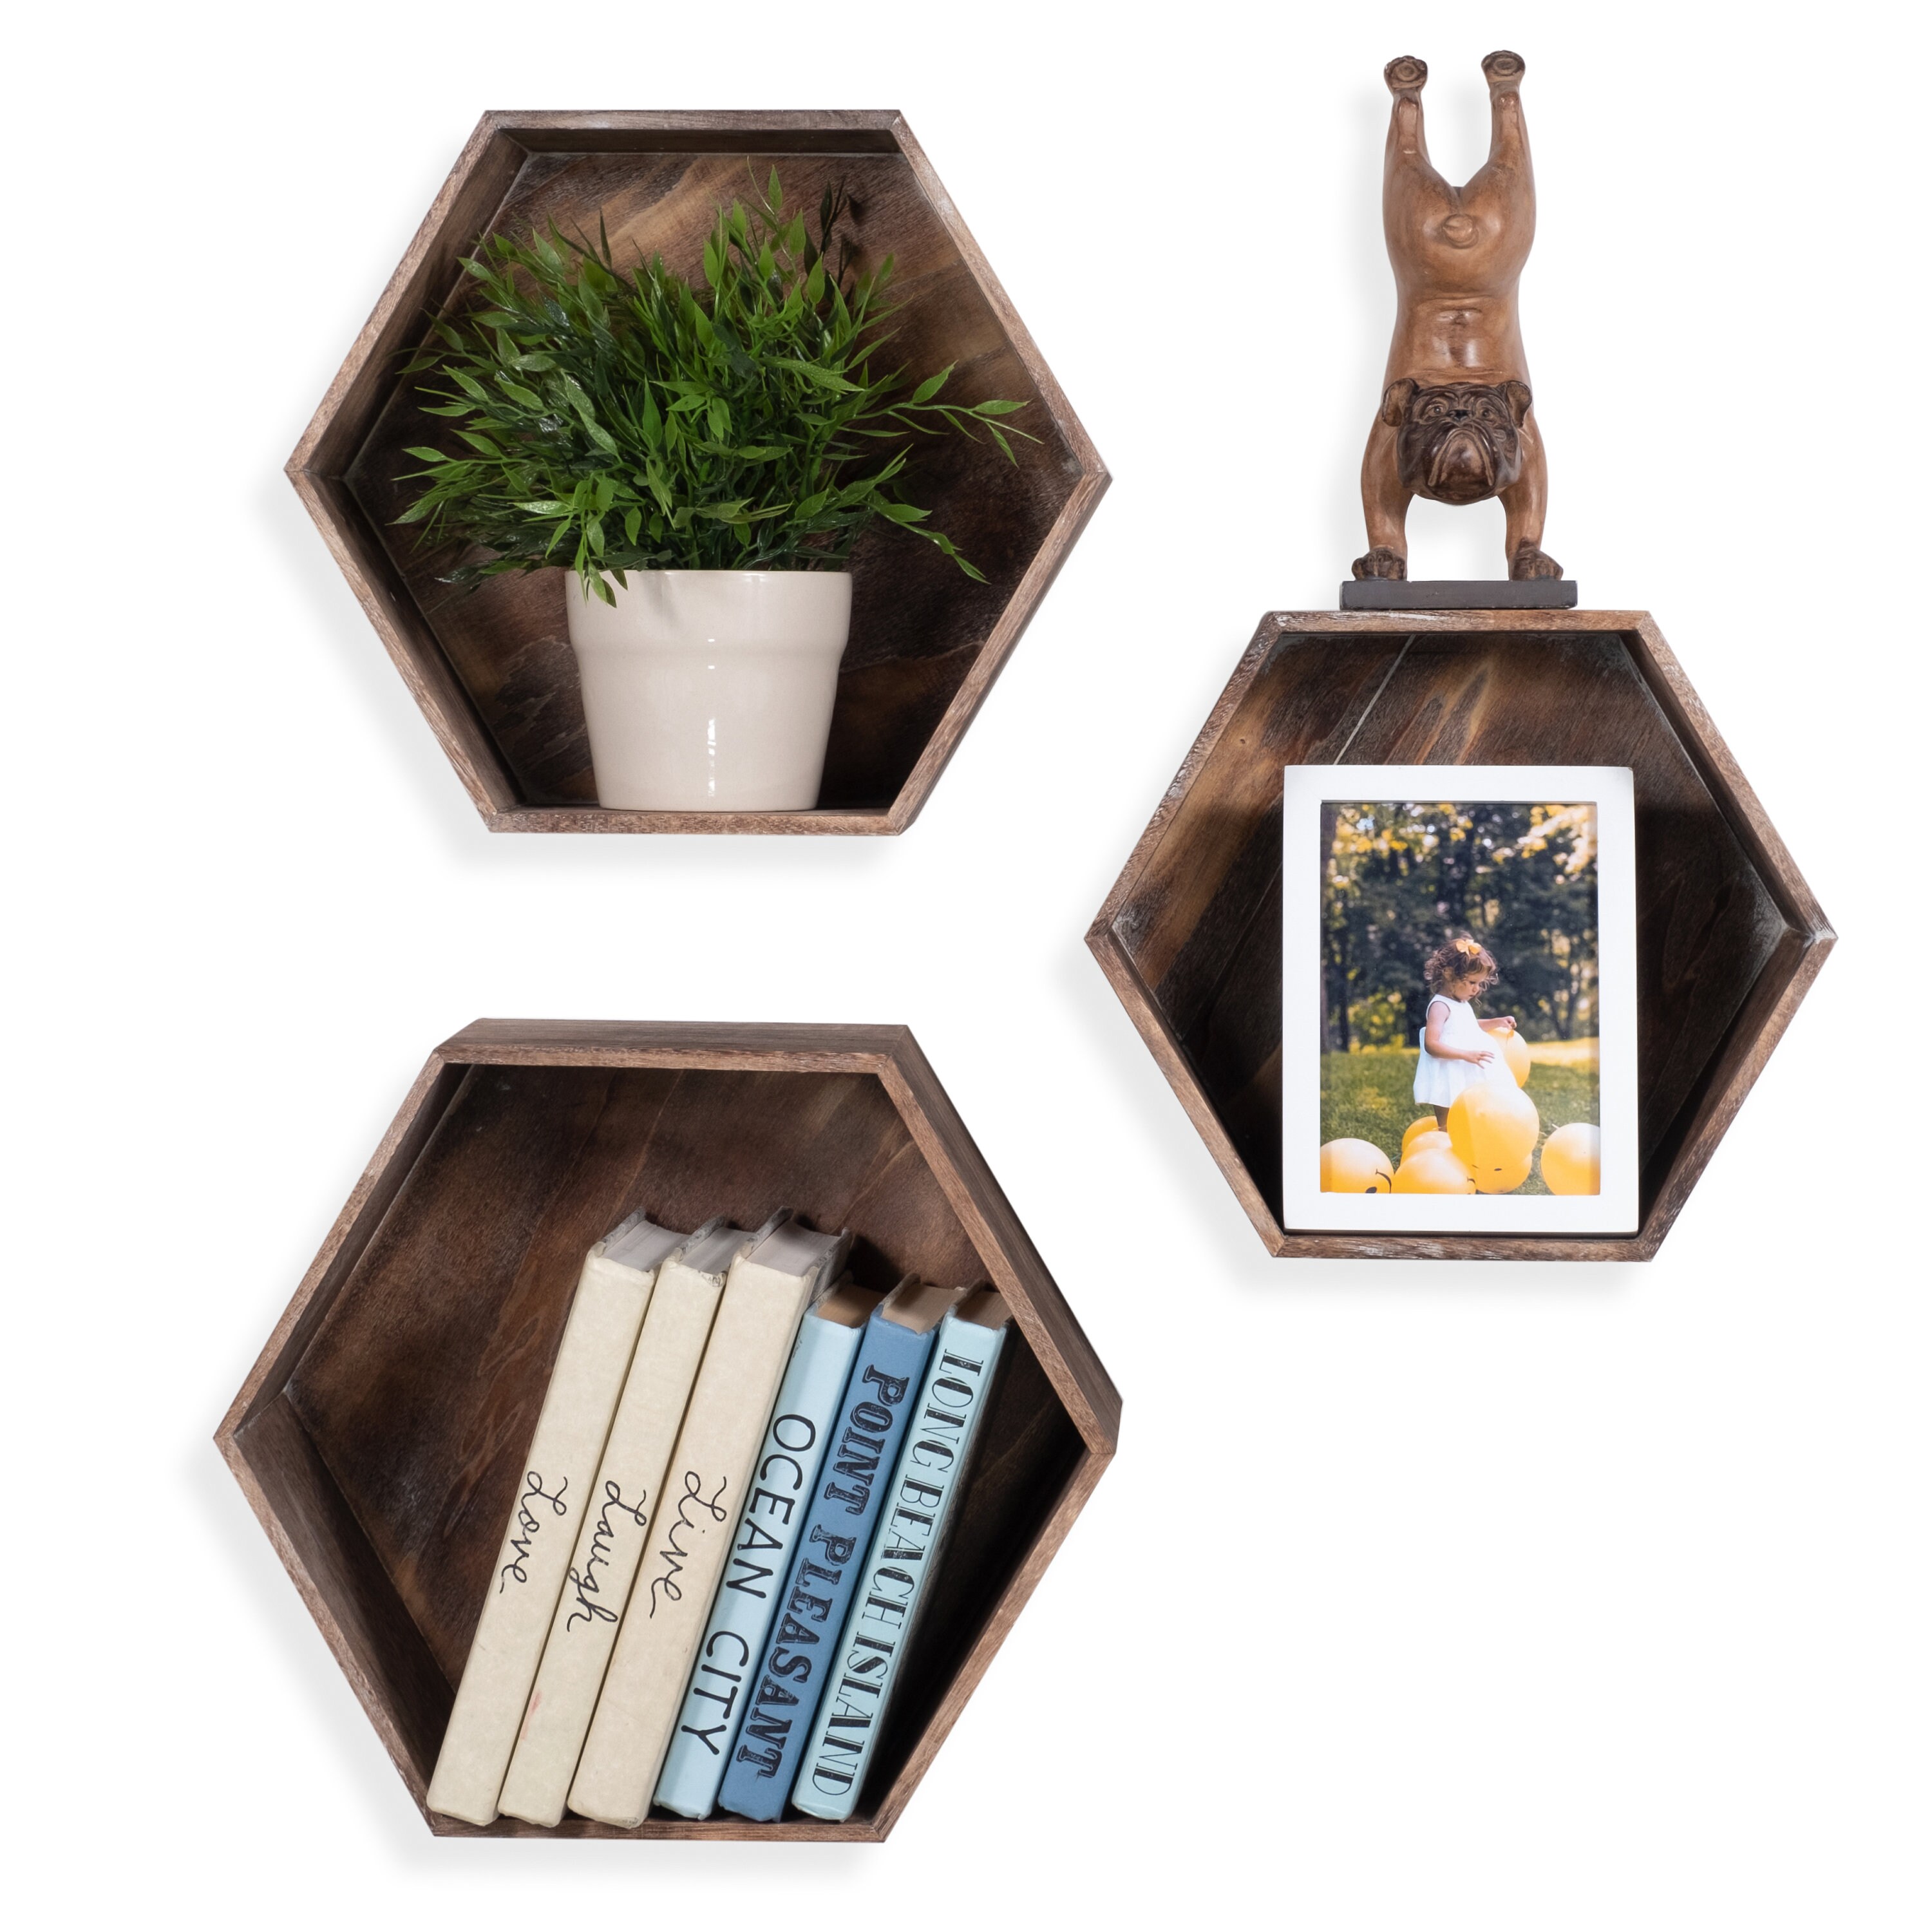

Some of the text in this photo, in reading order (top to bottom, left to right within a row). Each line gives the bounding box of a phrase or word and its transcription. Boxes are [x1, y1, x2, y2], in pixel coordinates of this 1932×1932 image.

[499, 1471, 568, 1594] Love
[566, 1479, 647, 1633] Laugh
[649, 1471, 727, 1618] Live
[681, 1414, 816, 1756] OCEAN CITY
[735, 1364, 909, 1779] POINT PLEASANT
[812, 1349, 983, 1796] LONG BEACH ISLAND
